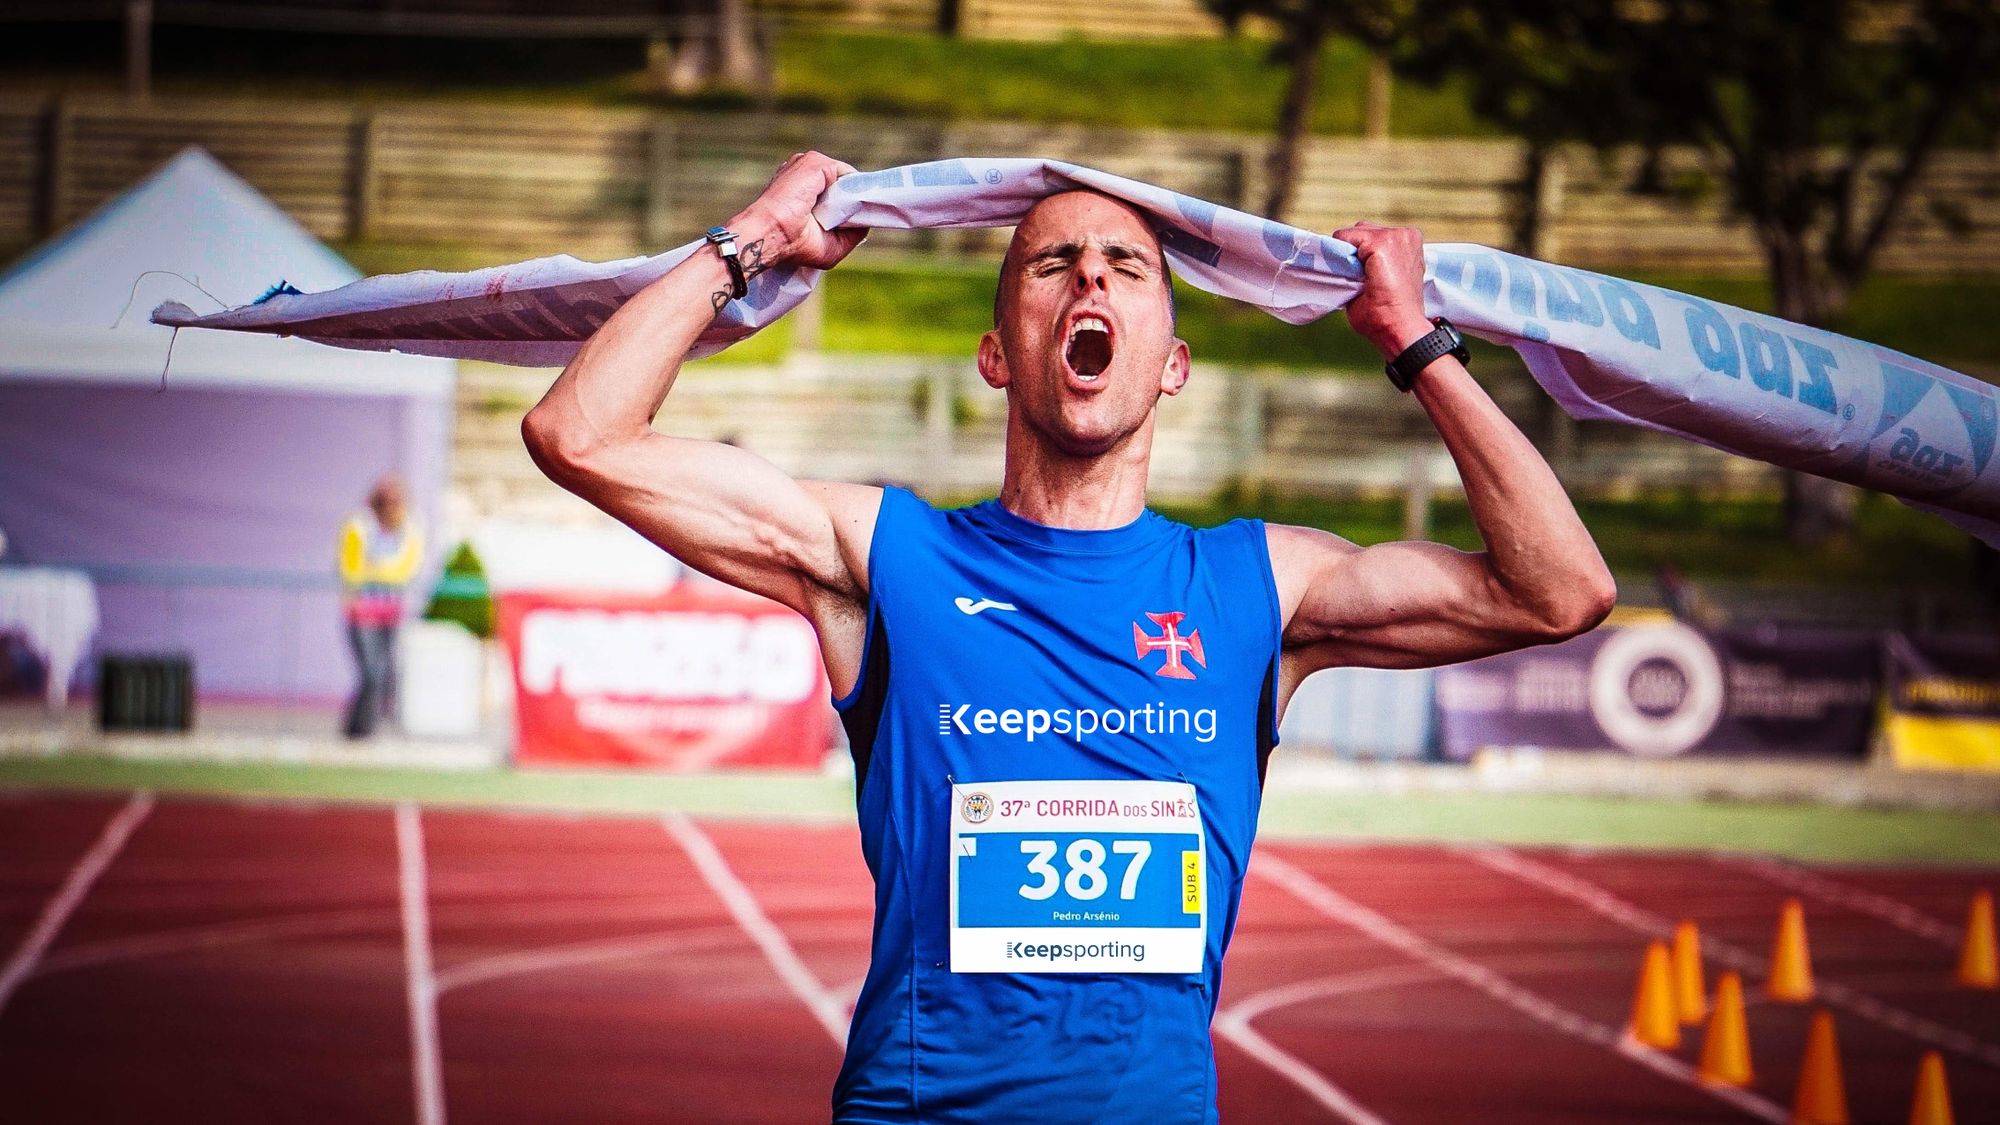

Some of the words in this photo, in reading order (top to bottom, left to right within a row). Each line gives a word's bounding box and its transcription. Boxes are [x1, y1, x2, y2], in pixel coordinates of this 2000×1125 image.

[939, 702, 1217, 742] Keepsporting
[1036, 800, 1119, 817] CORRIDA
[1123, 805, 1147, 817] DOS
[1018, 838, 1151, 900] 387
[1187, 862, 1196, 870] 4
[1187, 874, 1197, 902] SUB
[1053, 911, 1081, 920] Pedro
[1083, 911, 1120, 920] Arsénio
[1006, 941, 1145, 961] Keepsporting
